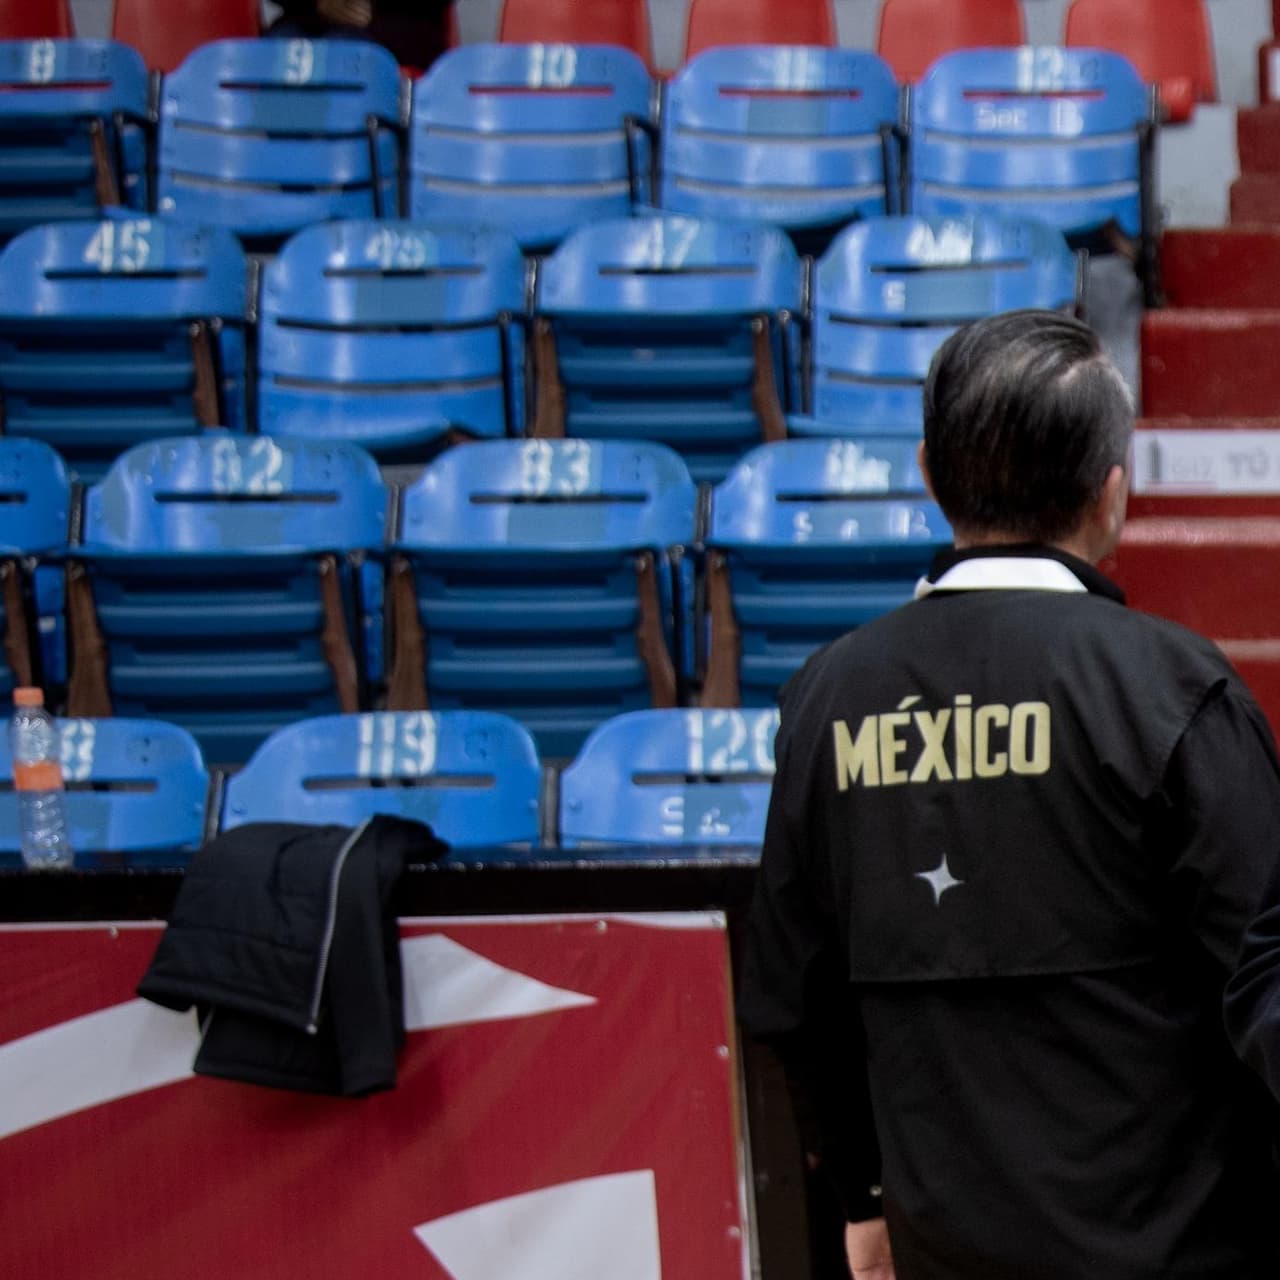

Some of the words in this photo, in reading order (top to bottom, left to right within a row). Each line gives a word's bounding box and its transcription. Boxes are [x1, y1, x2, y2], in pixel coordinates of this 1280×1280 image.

[284, 38, 314, 84] 9
[526, 40, 576, 87] 10
[1016, 47, 1063, 93] 12
[81, 220, 150, 273] 45
[210, 437, 281, 495] 82
[518, 438, 591, 493] 83
[357, 712, 436, 776] 119
